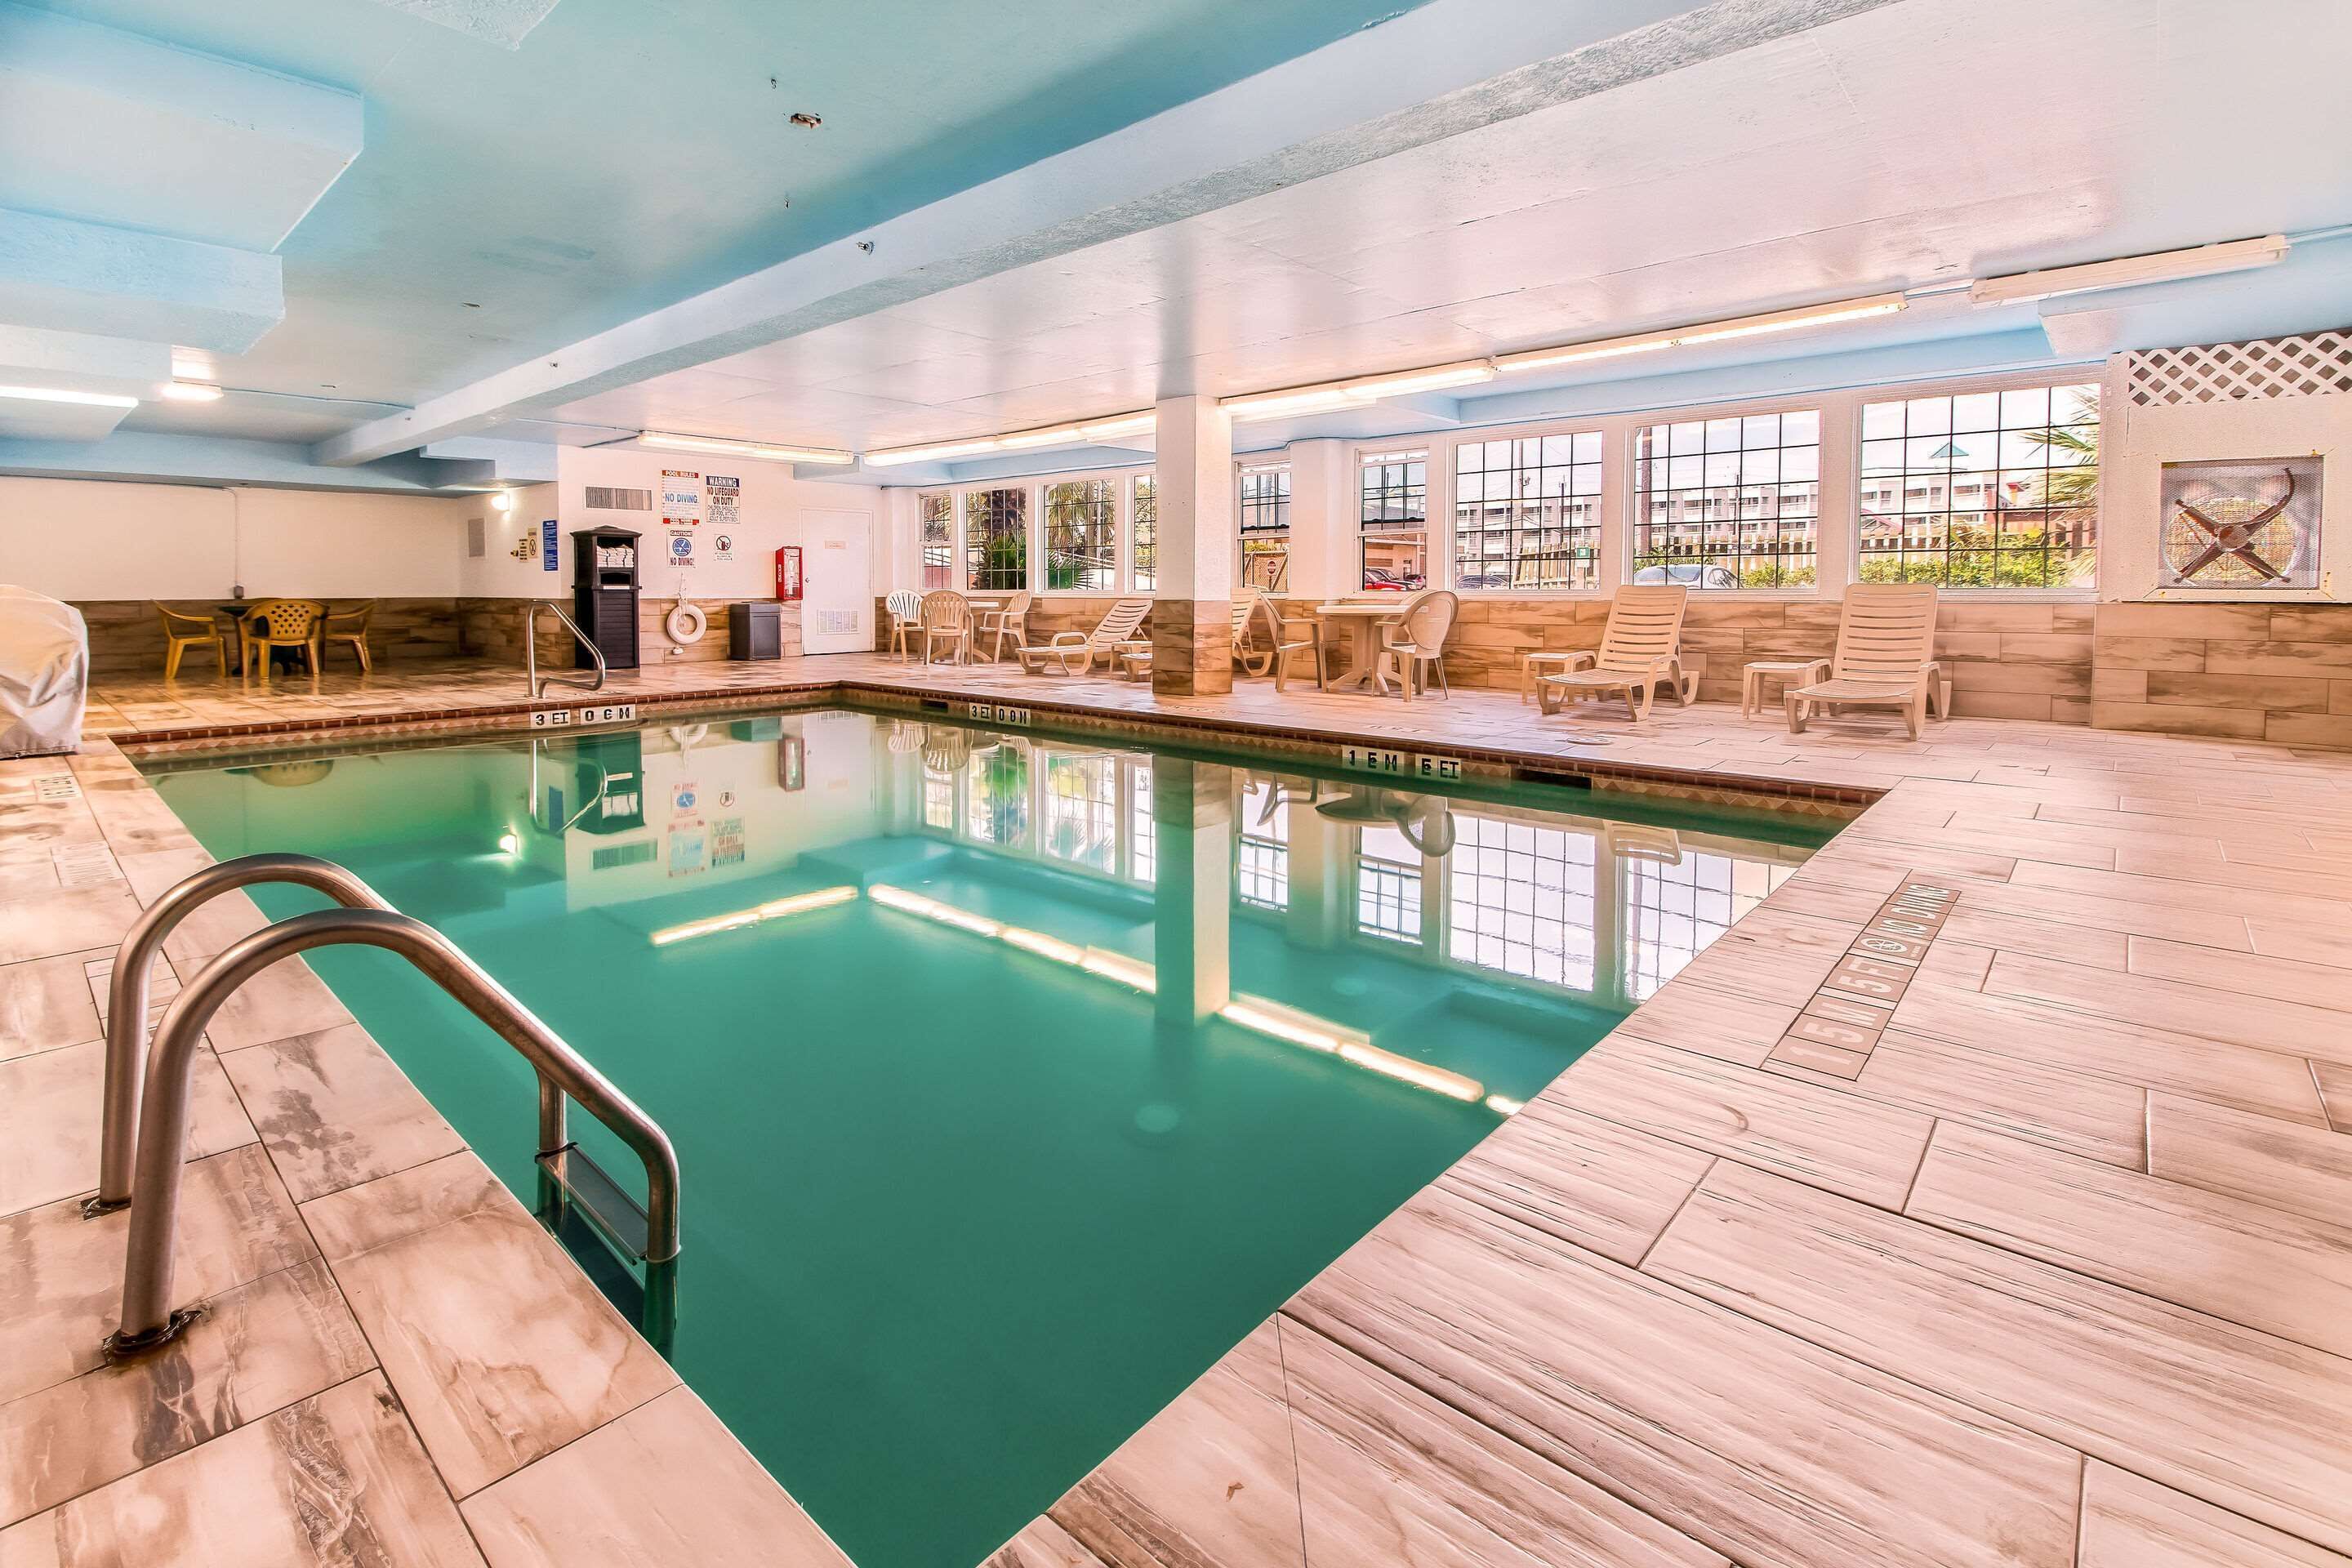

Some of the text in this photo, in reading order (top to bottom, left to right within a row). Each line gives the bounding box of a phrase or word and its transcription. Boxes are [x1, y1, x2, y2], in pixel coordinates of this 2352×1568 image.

[708, 477, 737, 487] WARNING
[706, 487, 739, 497] NO LIFEGUARD
[665, 493, 675, 502] NO
[713, 497, 733, 506] ON DUTY
[670, 557, 676, 565] NO
